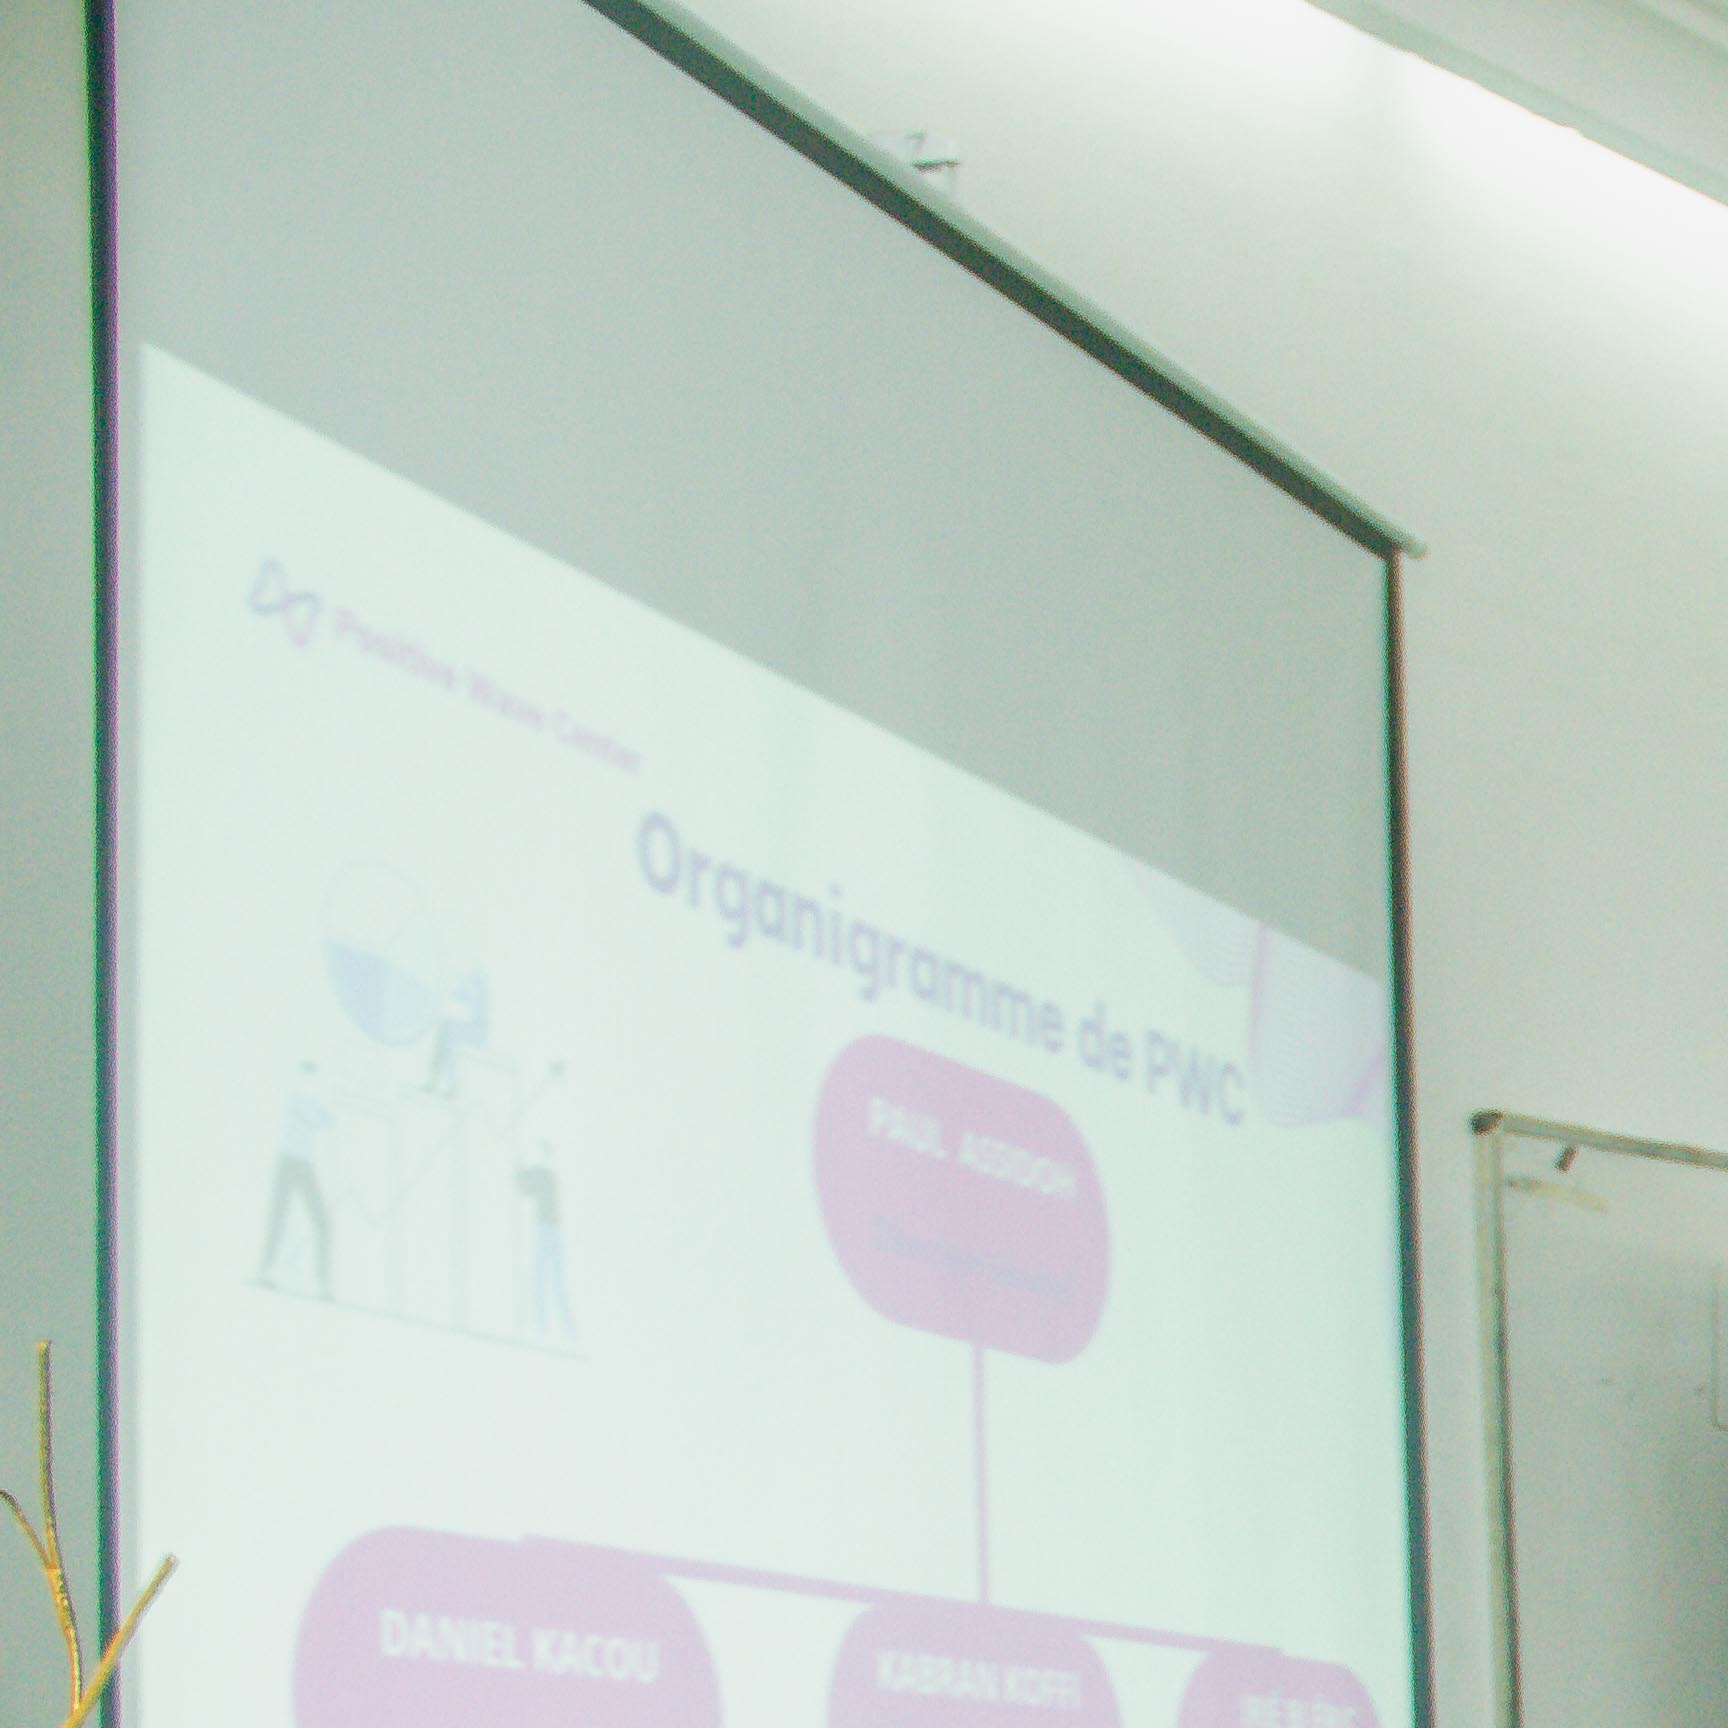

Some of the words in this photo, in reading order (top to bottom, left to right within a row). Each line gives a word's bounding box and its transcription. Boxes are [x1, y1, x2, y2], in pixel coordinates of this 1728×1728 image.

[637, 809, 1064, 1053] Organigramme
[1077, 1000, 1133, 1082] de
[1146, 1027, 1246, 1127] PWC
[378, 1608, 525, 1670] DANIEL
[532, 1626, 661, 1684] KACOU
